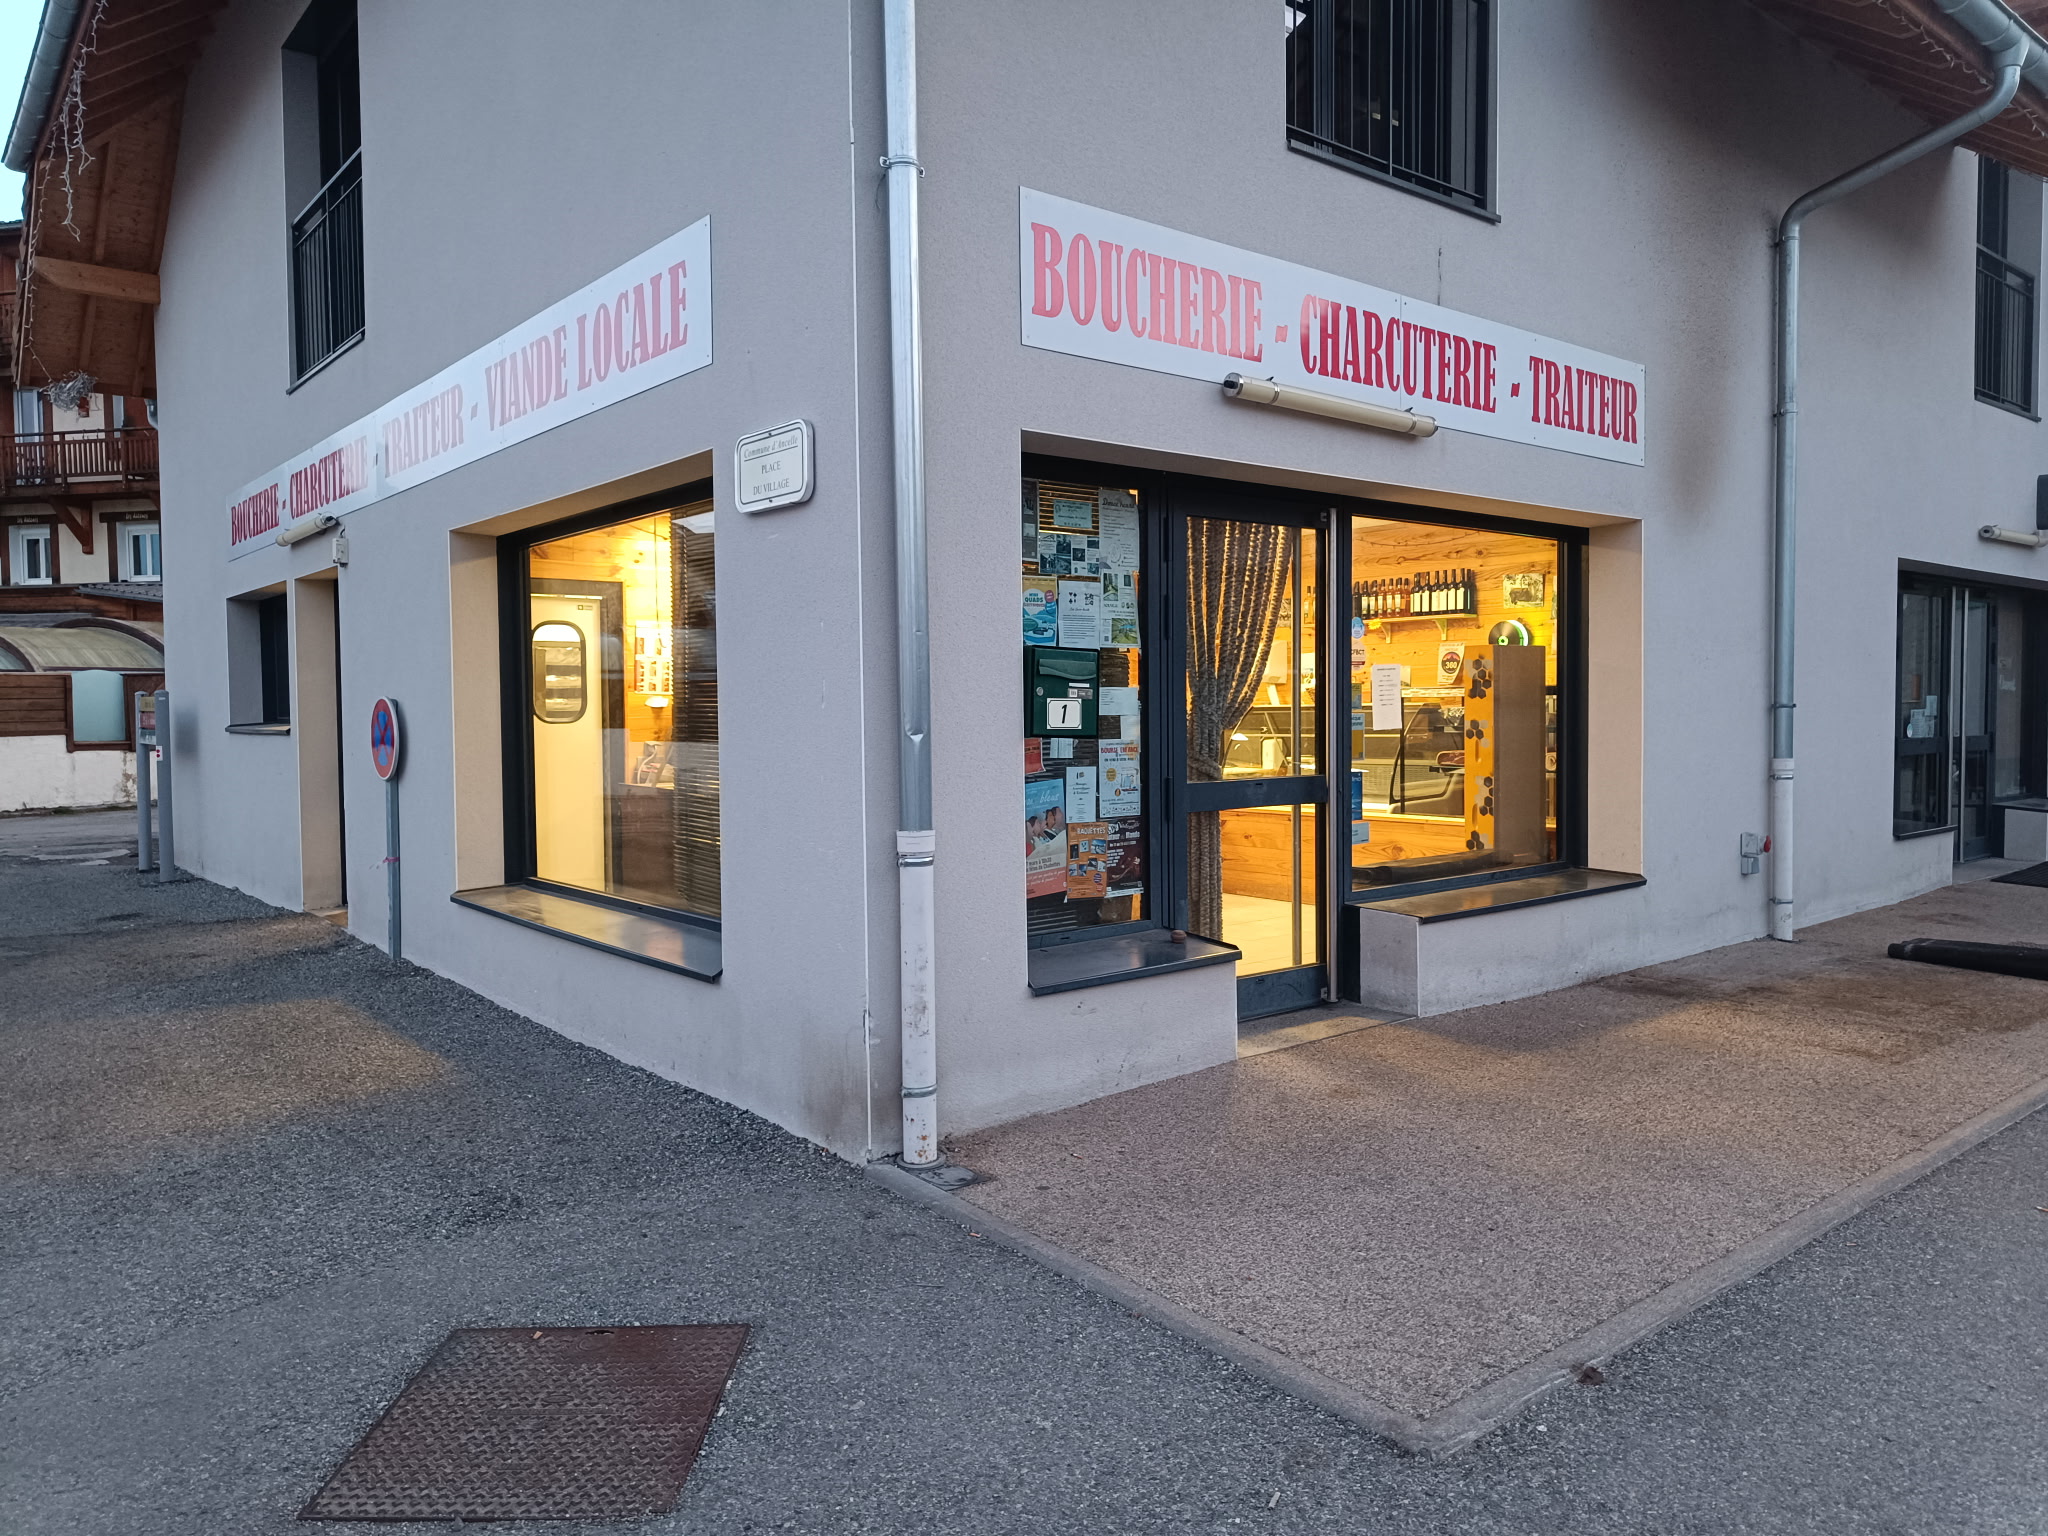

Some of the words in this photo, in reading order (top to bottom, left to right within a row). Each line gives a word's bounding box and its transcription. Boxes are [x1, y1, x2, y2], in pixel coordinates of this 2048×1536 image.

[1031, 222, 1263, 363] BOUCHERIE
[1299, 294, 1497, 414] CHARCUTERIE
[1529, 355, 1638, 445] TRAITEUR
[231, 483, 280, 547] BOUCHERIE
[289, 436, 369, 521] CHARCUTERIE
[382, 383, 465, 479] TRAITEUR
[484, 324, 569, 432] VIANDE
[576, 260, 689, 392] LOCALE
[744, 445, 770, 459] Commune
[761, 461, 781, 474] PLACE
[753, 484, 762, 495] DU
[763, 478, 790, 493] VILLAGE
[1061, 704, 1068, 724] 1
[1076, 826, 1106, 835] RAQUETTES
